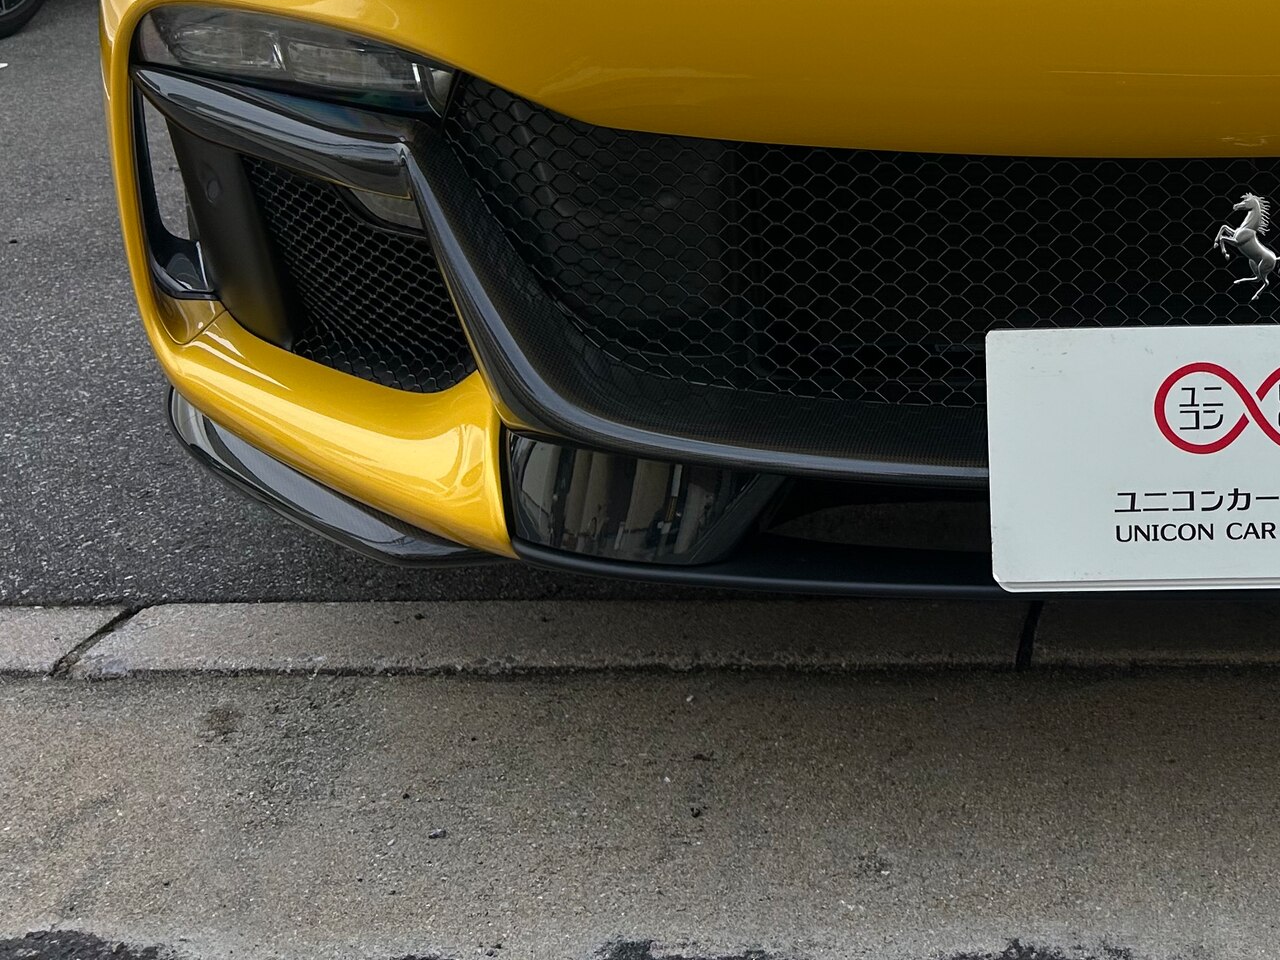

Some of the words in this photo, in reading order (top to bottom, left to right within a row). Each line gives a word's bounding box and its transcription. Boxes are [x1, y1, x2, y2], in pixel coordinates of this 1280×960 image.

[1179, 386, 1223, 407] ユニ
[1179, 410, 1223, 431] コン
[1115, 522, 1214, 542] UNICON
[1226, 521, 1276, 541] CAR
